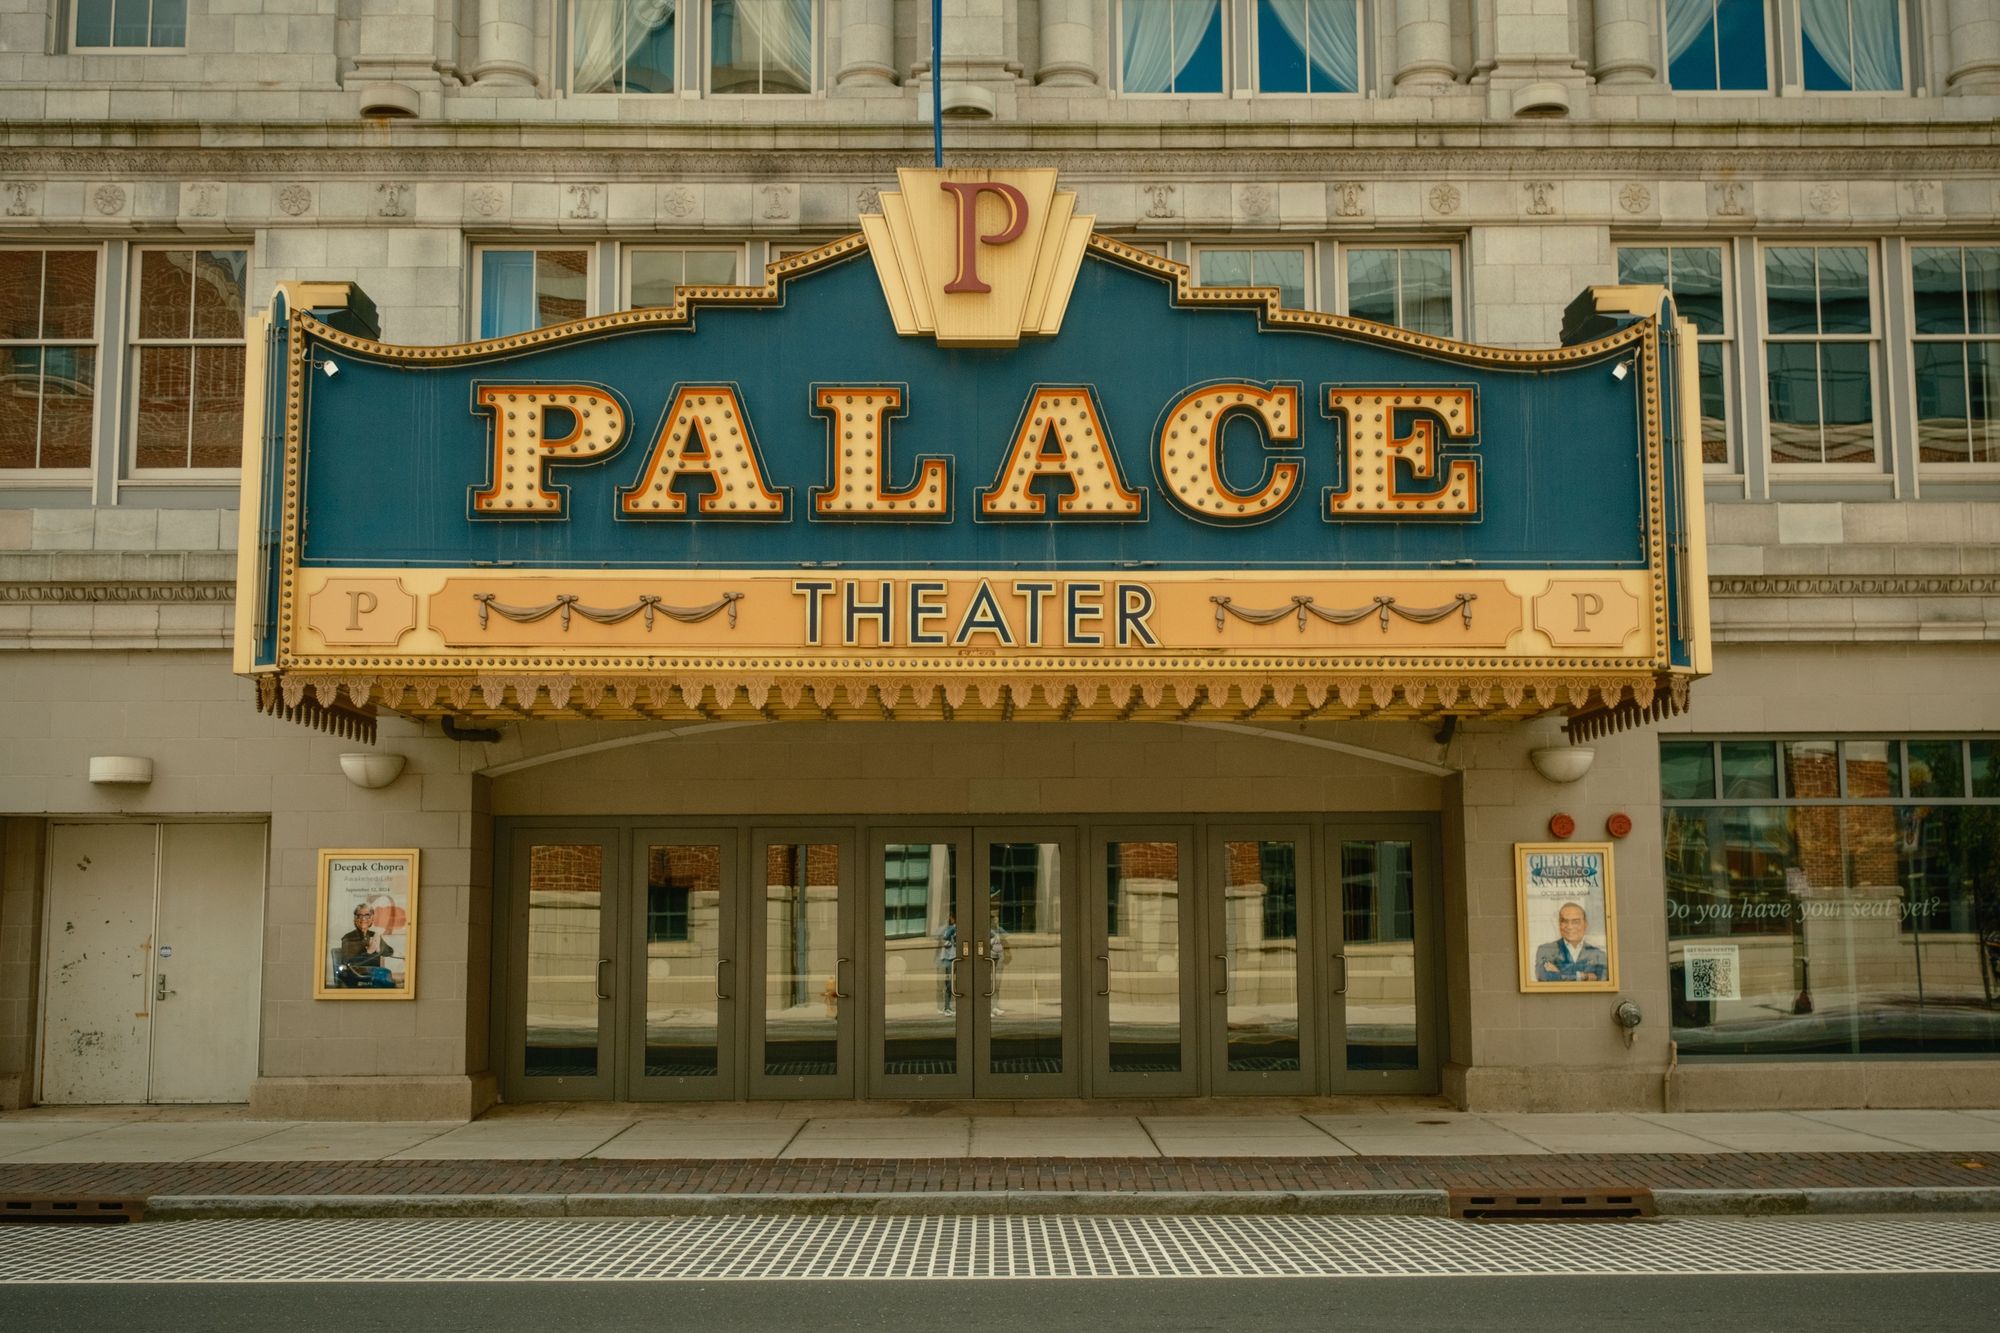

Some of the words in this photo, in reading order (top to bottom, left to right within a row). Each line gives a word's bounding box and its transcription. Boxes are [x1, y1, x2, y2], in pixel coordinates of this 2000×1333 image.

[940, 181, 1029, 294] P
[473, 382, 1478, 518] PALACE
[345, 591, 378, 631] P
[792, 577, 1164, 648] THEATER
[1571, 592, 1604, 632] P
[334, 863, 368, 873] Deepak
[371, 862, 404, 873] Chopra
[1695, 904, 1732, 924] you
[1741, 897, 1791, 918] have
[1852, 899, 1891, 917] seat
[1898, 896, 1940, 922] yet?
